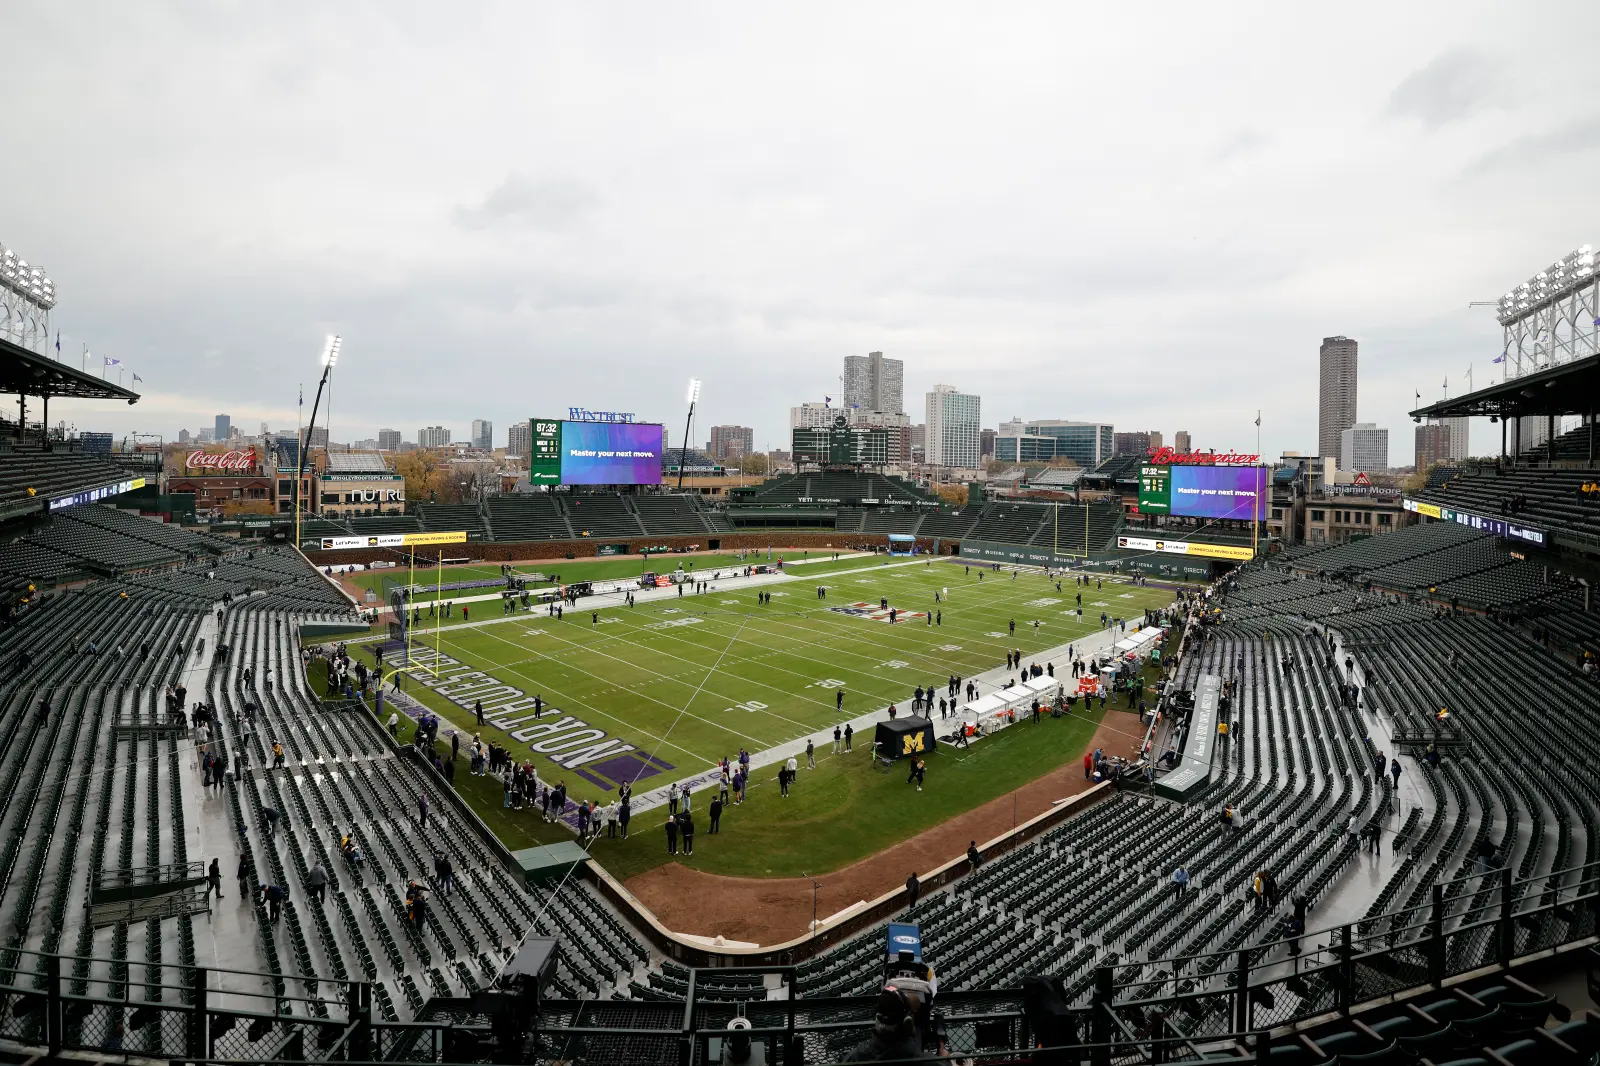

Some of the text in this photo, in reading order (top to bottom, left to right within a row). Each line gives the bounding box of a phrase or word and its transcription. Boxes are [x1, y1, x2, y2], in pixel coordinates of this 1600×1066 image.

[185, 450, 254, 469] Coca-Cola
[570, 449, 596, 457] Master
[597, 451, 615, 459] your
[1146, 446, 1260, 464] Budweiser
[1324, 484, 1402, 496] Benjamin Moore
[735, 700, 769, 713] 10
[903, 731, 925, 755] M
